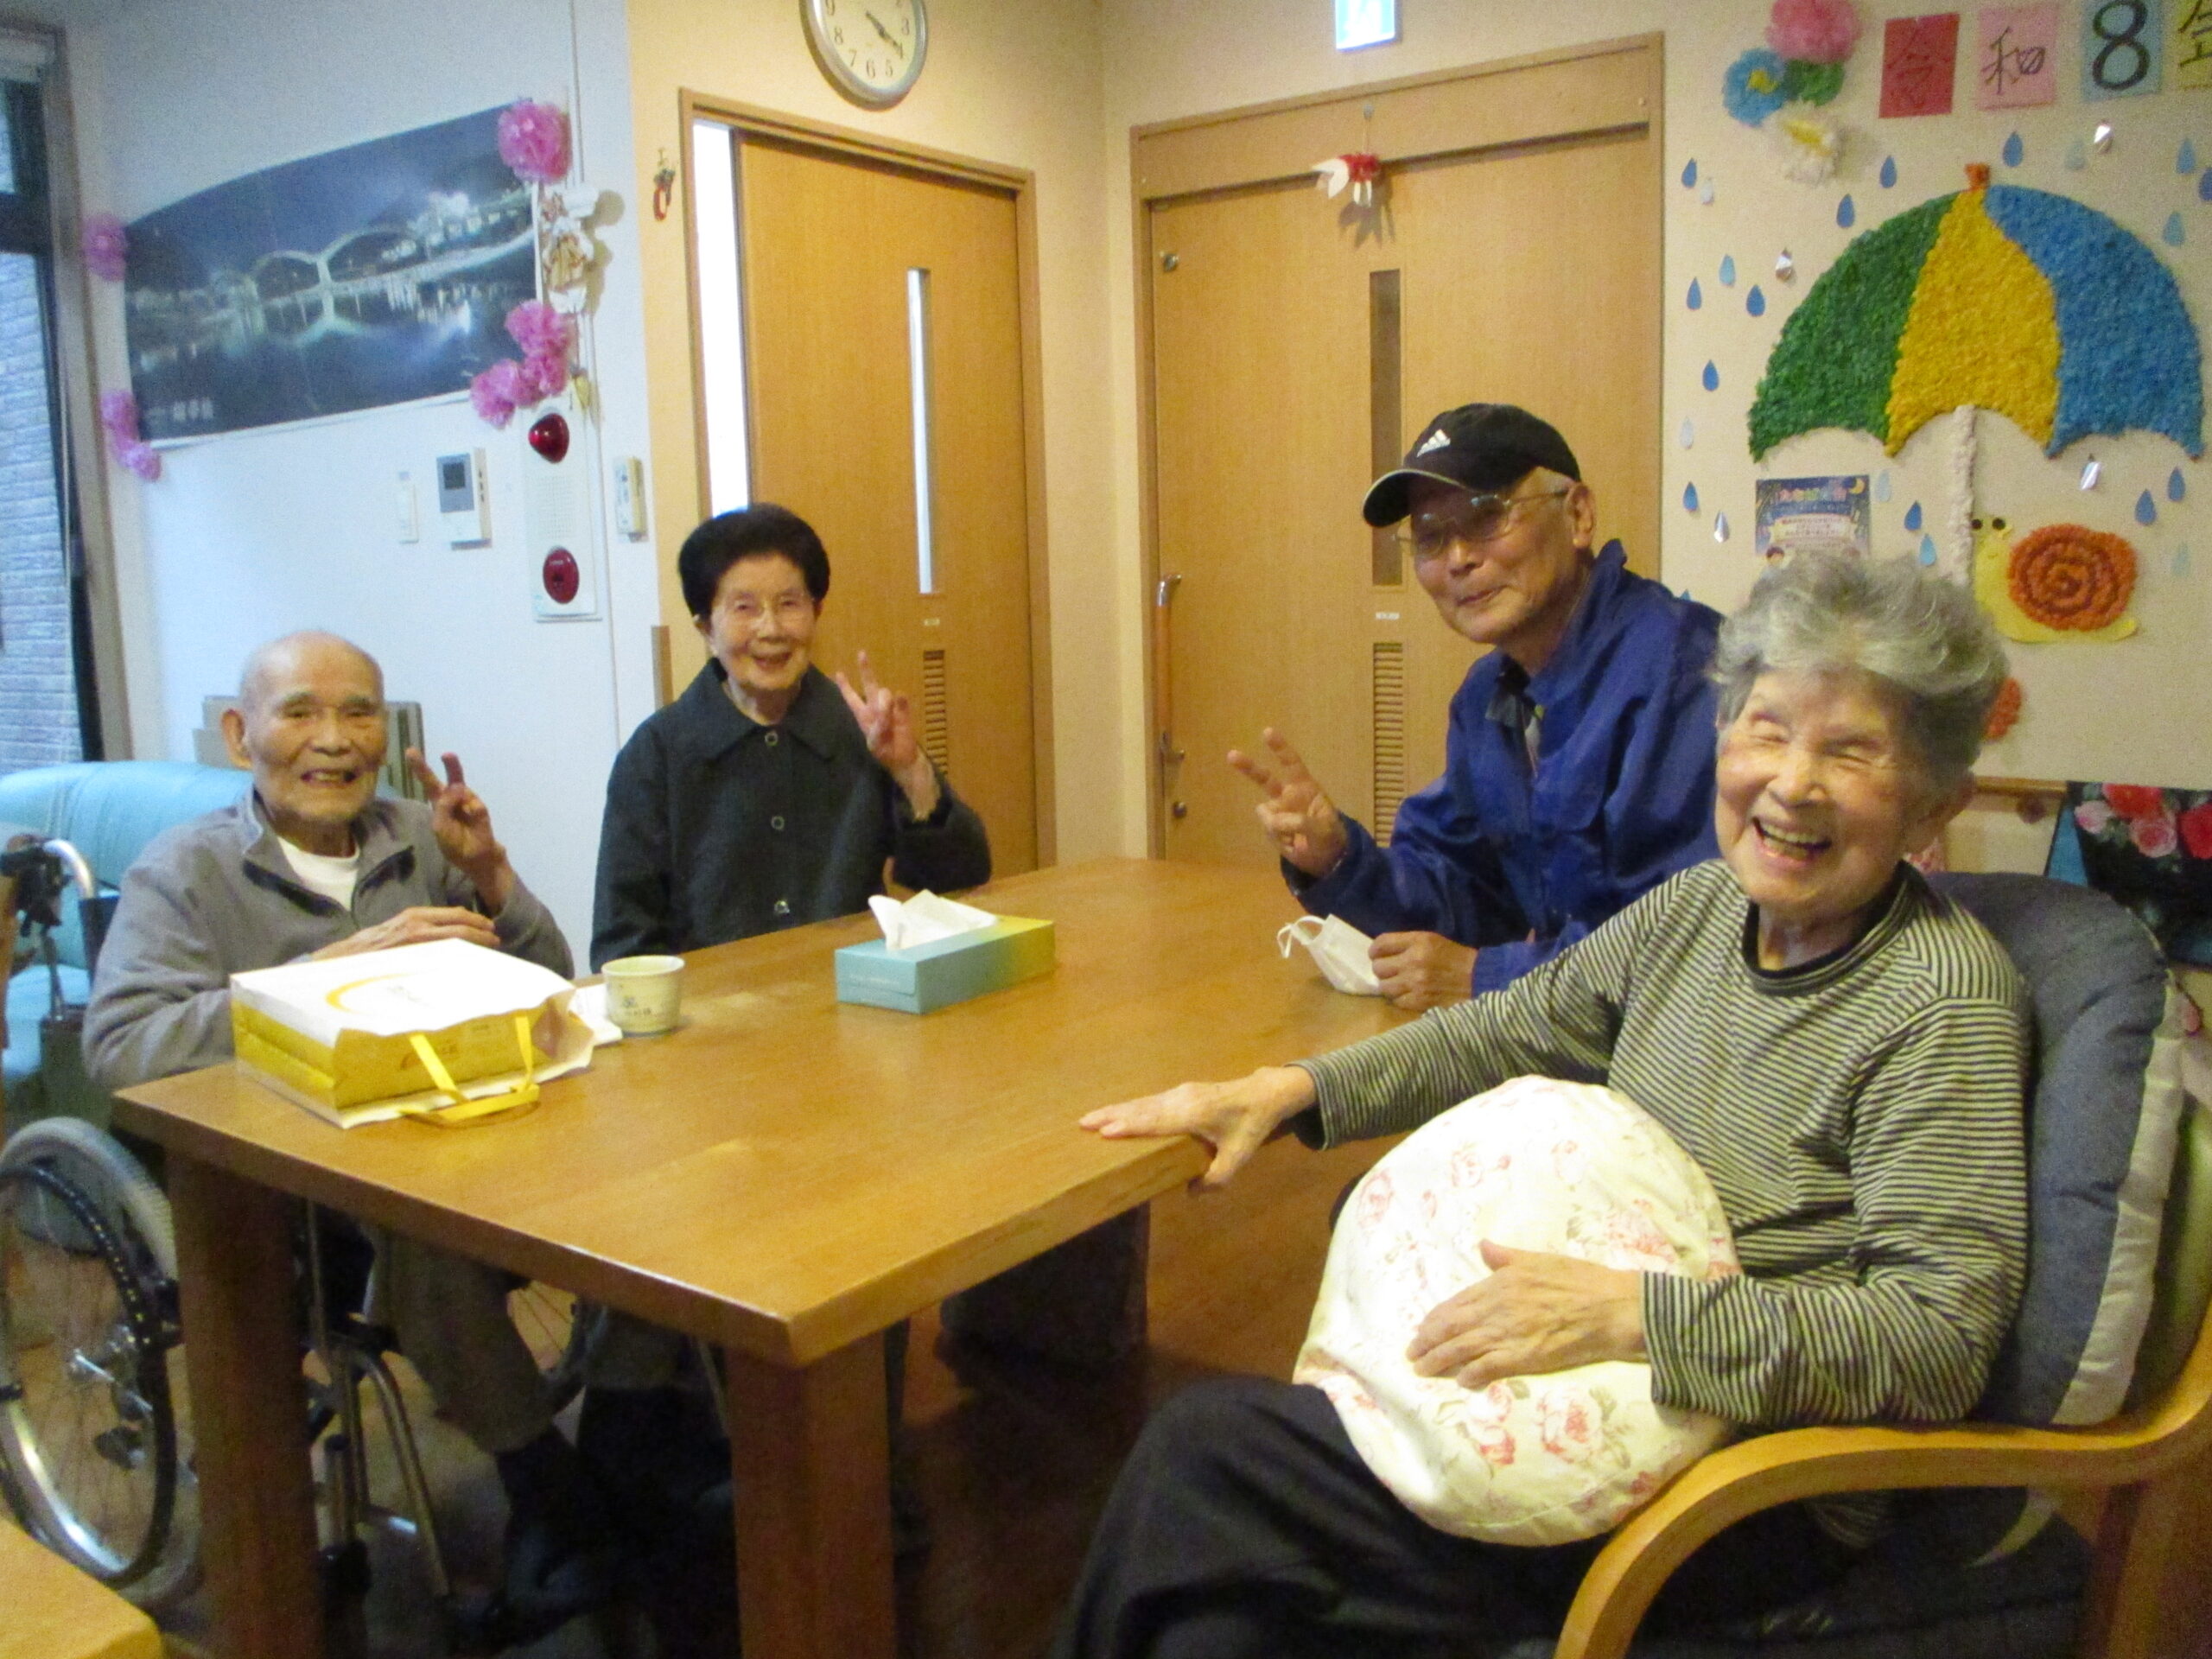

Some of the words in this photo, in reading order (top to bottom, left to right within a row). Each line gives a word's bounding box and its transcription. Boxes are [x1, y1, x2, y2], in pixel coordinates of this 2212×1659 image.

[834, 27, 843, 45] 8
[901, 17, 910, 36] 3
[849, 48, 857, 67] 7
[866, 58, 876, 79] 6
[885, 59, 893, 78] 5
